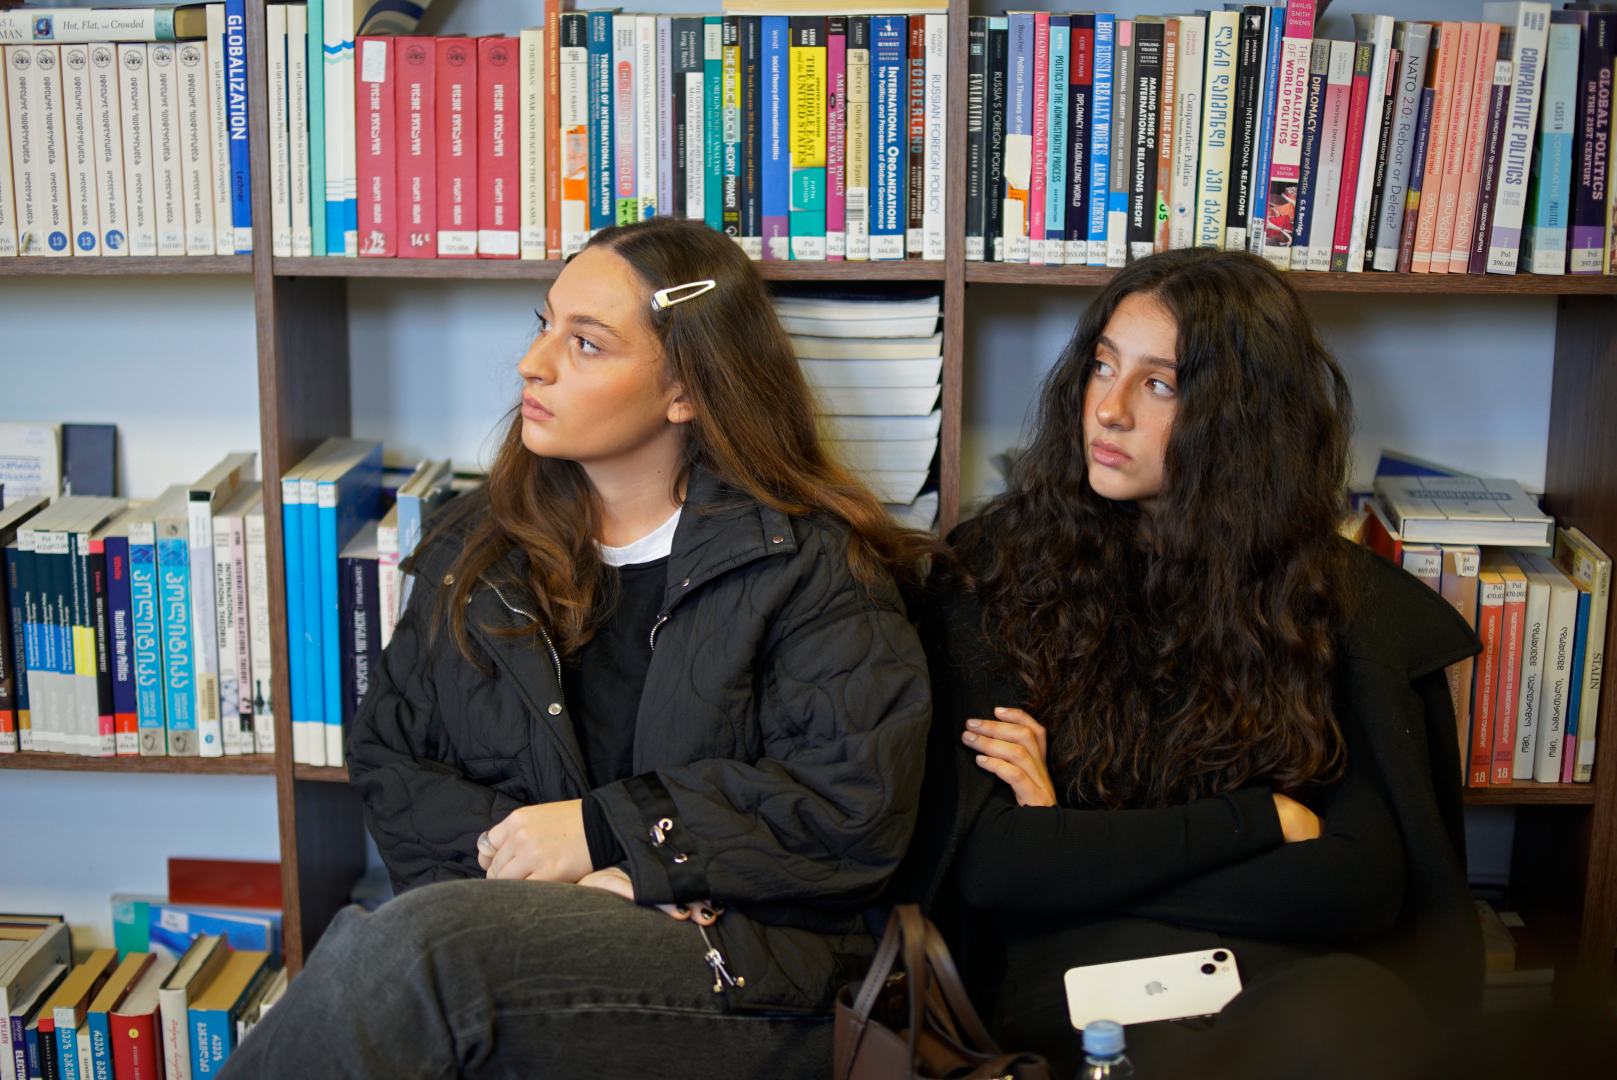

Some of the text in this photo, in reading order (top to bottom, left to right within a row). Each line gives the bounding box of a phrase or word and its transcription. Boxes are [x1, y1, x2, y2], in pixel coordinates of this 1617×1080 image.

[63, 20, 79, 31] Hot,
[82, 20, 100, 30] Flat,
[111, 20, 144, 30] Crowded
[1213, 26, 1233, 66] ლარი
[228, 15, 246, 140] GLOBALIZATION
[601, 94, 609, 104] OF
[878, 67, 886, 77] The
[878, 80, 886, 102] Politics
[969, 74, 983, 132] EVALUATION
[1016, 57, 1024, 83] Political
[1016, 85, 1024, 113] Theories
[1093, 21, 1109, 155] HOW RUSSIA REALLY WORKS
[1162, 43, 1175, 158] UNDERSTANDING PUBLIC POLICY
[1279, 44, 1296, 144] OF WORLD POLITICS
[1290, 45, 1308, 147] THE GLOBALIZATION
[43, 77, 56, 164] დემოკრატიის პროექტი
[601, 106, 609, 169] INTERNATIONAL
[620, 67, 630, 189] THE TRUSTED LEADER
[726, 49, 735, 207] THE PUBLIC POLICY THEORY PRIMER
[797, 51, 806, 163] and the UNITED STATES
[806, 56, 815, 158] THE MIDDLE EAST
[836, 73, 844, 196] AMERICAN FOREIGN POLICY
[878, 105, 886, 117] and
[878, 120, 886, 152] Processes
[912, 59, 924, 153] BORDERLAND
[991, 72, 1002, 181] RUSSIA'S FOREIGN POLICY
[1035, 23, 1046, 190] THEORY OF INTERNATIONAL POLITICS
[1052, 56, 1064, 182] POLITICS OF THE ADMINISTRATIVE PROCESS
[1147, 77, 1156, 148] MAKING SENSE OF
[1182, 93, 1196, 186] Comparative Politics
[1506, 48, 1538, 184] COMPARATIVE POLITICS
[1554, 102, 1564, 121] CASES
[1583, 82, 1596, 186] IN THE 21ST CENTURY
[1592, 69, 1610, 200] GLOBAL POLITICS
[878, 163, 886, 182] Global
[888, 67, 899, 229] INTERNATIONAL ORGANIZATIONS
[930, 74, 941, 214] RUSSIAN FOREIGN POLICY
[1134, 77, 1148, 227] INTERNATIONAL RELATIONS THEORY
[1386, 56, 1419, 229] NATO 2.0: Reboot or Delete?
[1551, 135, 1562, 198] COMPARATIVE
[237, 171, 245, 202] Lechner
[601, 171, 609, 215] RELATIONS
[878, 186, 886, 229] Governance
[1205, 170, 1224, 191] ავი
[1548, 202, 1558, 226] POLITICS
[52, 237, 63, 246] 13
[1436, 194, 1455, 250] NISPAcee
[113, 556, 122, 579] White
[225, 563, 234, 628] INTERNATIONAL
[254, 554, 268, 644] Foreign Policy
[1600, 567, 1608, 596] CAMERON
[133, 570, 156, 685] პოლიტიკა
[165, 572, 188, 688] პოლიტიკა
[217, 563, 226, 648] RELATIONS THEORIES
[235, 558, 247, 684] INTERNATIONAL RELATIONS THEORY
[114, 611, 128, 681] Russia's New Politics
[1590, 653, 1601, 689] STALIN
[1522, 623, 1540, 753] ომი, სამართალი, მშვიდობა
[1549, 627, 1568, 757] ომი, სამართალი, მშვიდობა
[1475, 772, 1485, 782] 18
[1497, 768, 1508, 778] 18
[15, 1051, 25, 1080] ELECTO
[93, 1031, 104, 1057] რევაზ
[197, 1022, 209, 1072] გაჩეჩილაძე
[212, 1035, 222, 1061] რევაზ
